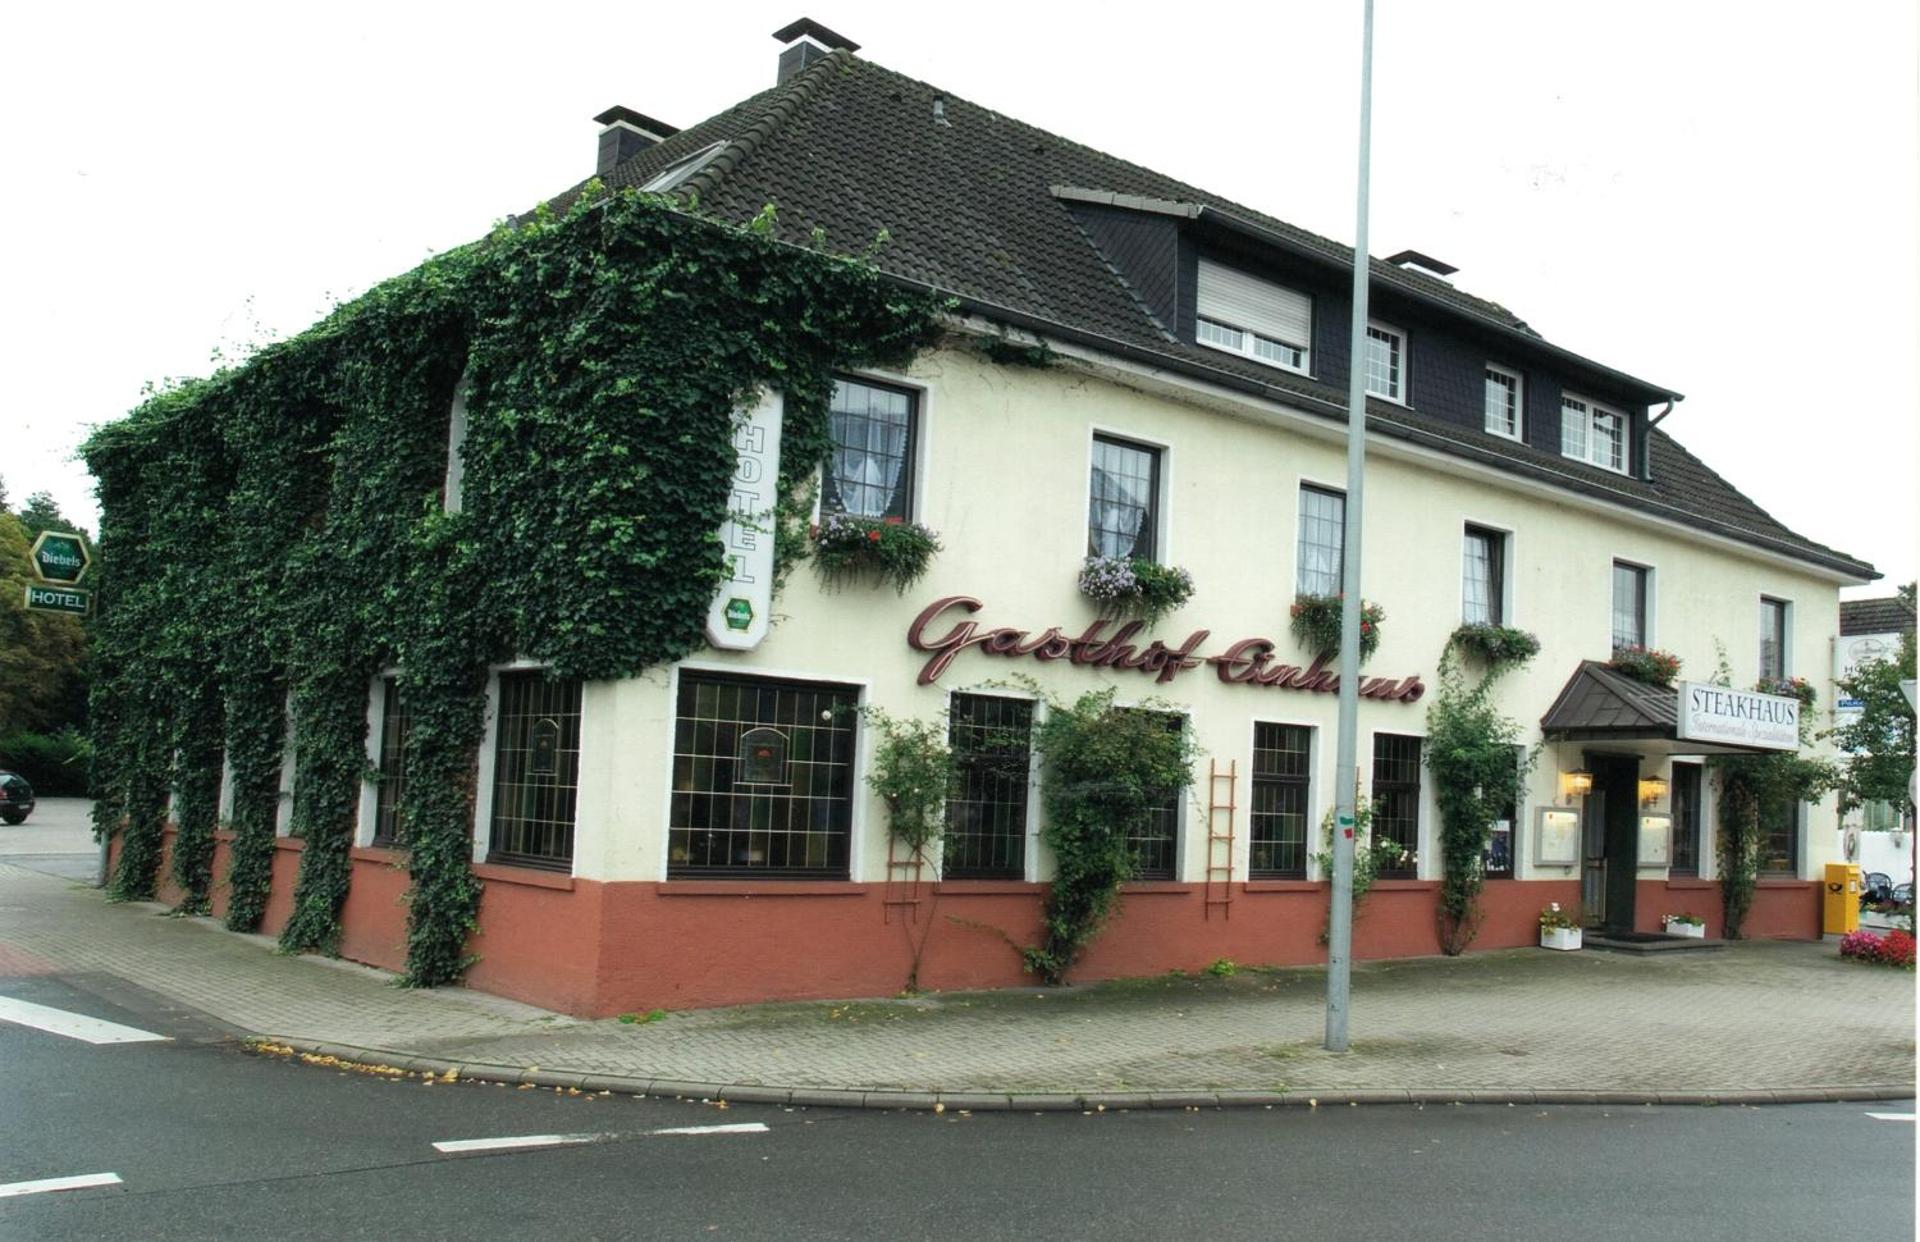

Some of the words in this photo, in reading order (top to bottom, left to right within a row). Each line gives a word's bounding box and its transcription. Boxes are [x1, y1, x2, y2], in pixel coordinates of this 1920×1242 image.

[731, 425, 765, 584] HOTEL
[42, 551, 81, 567] Diebels
[31, 590, 85, 608] HOTEL
[907, 596, 1210, 686] Gasthof
[1692, 688, 1796, 726] STEAKHAUS
